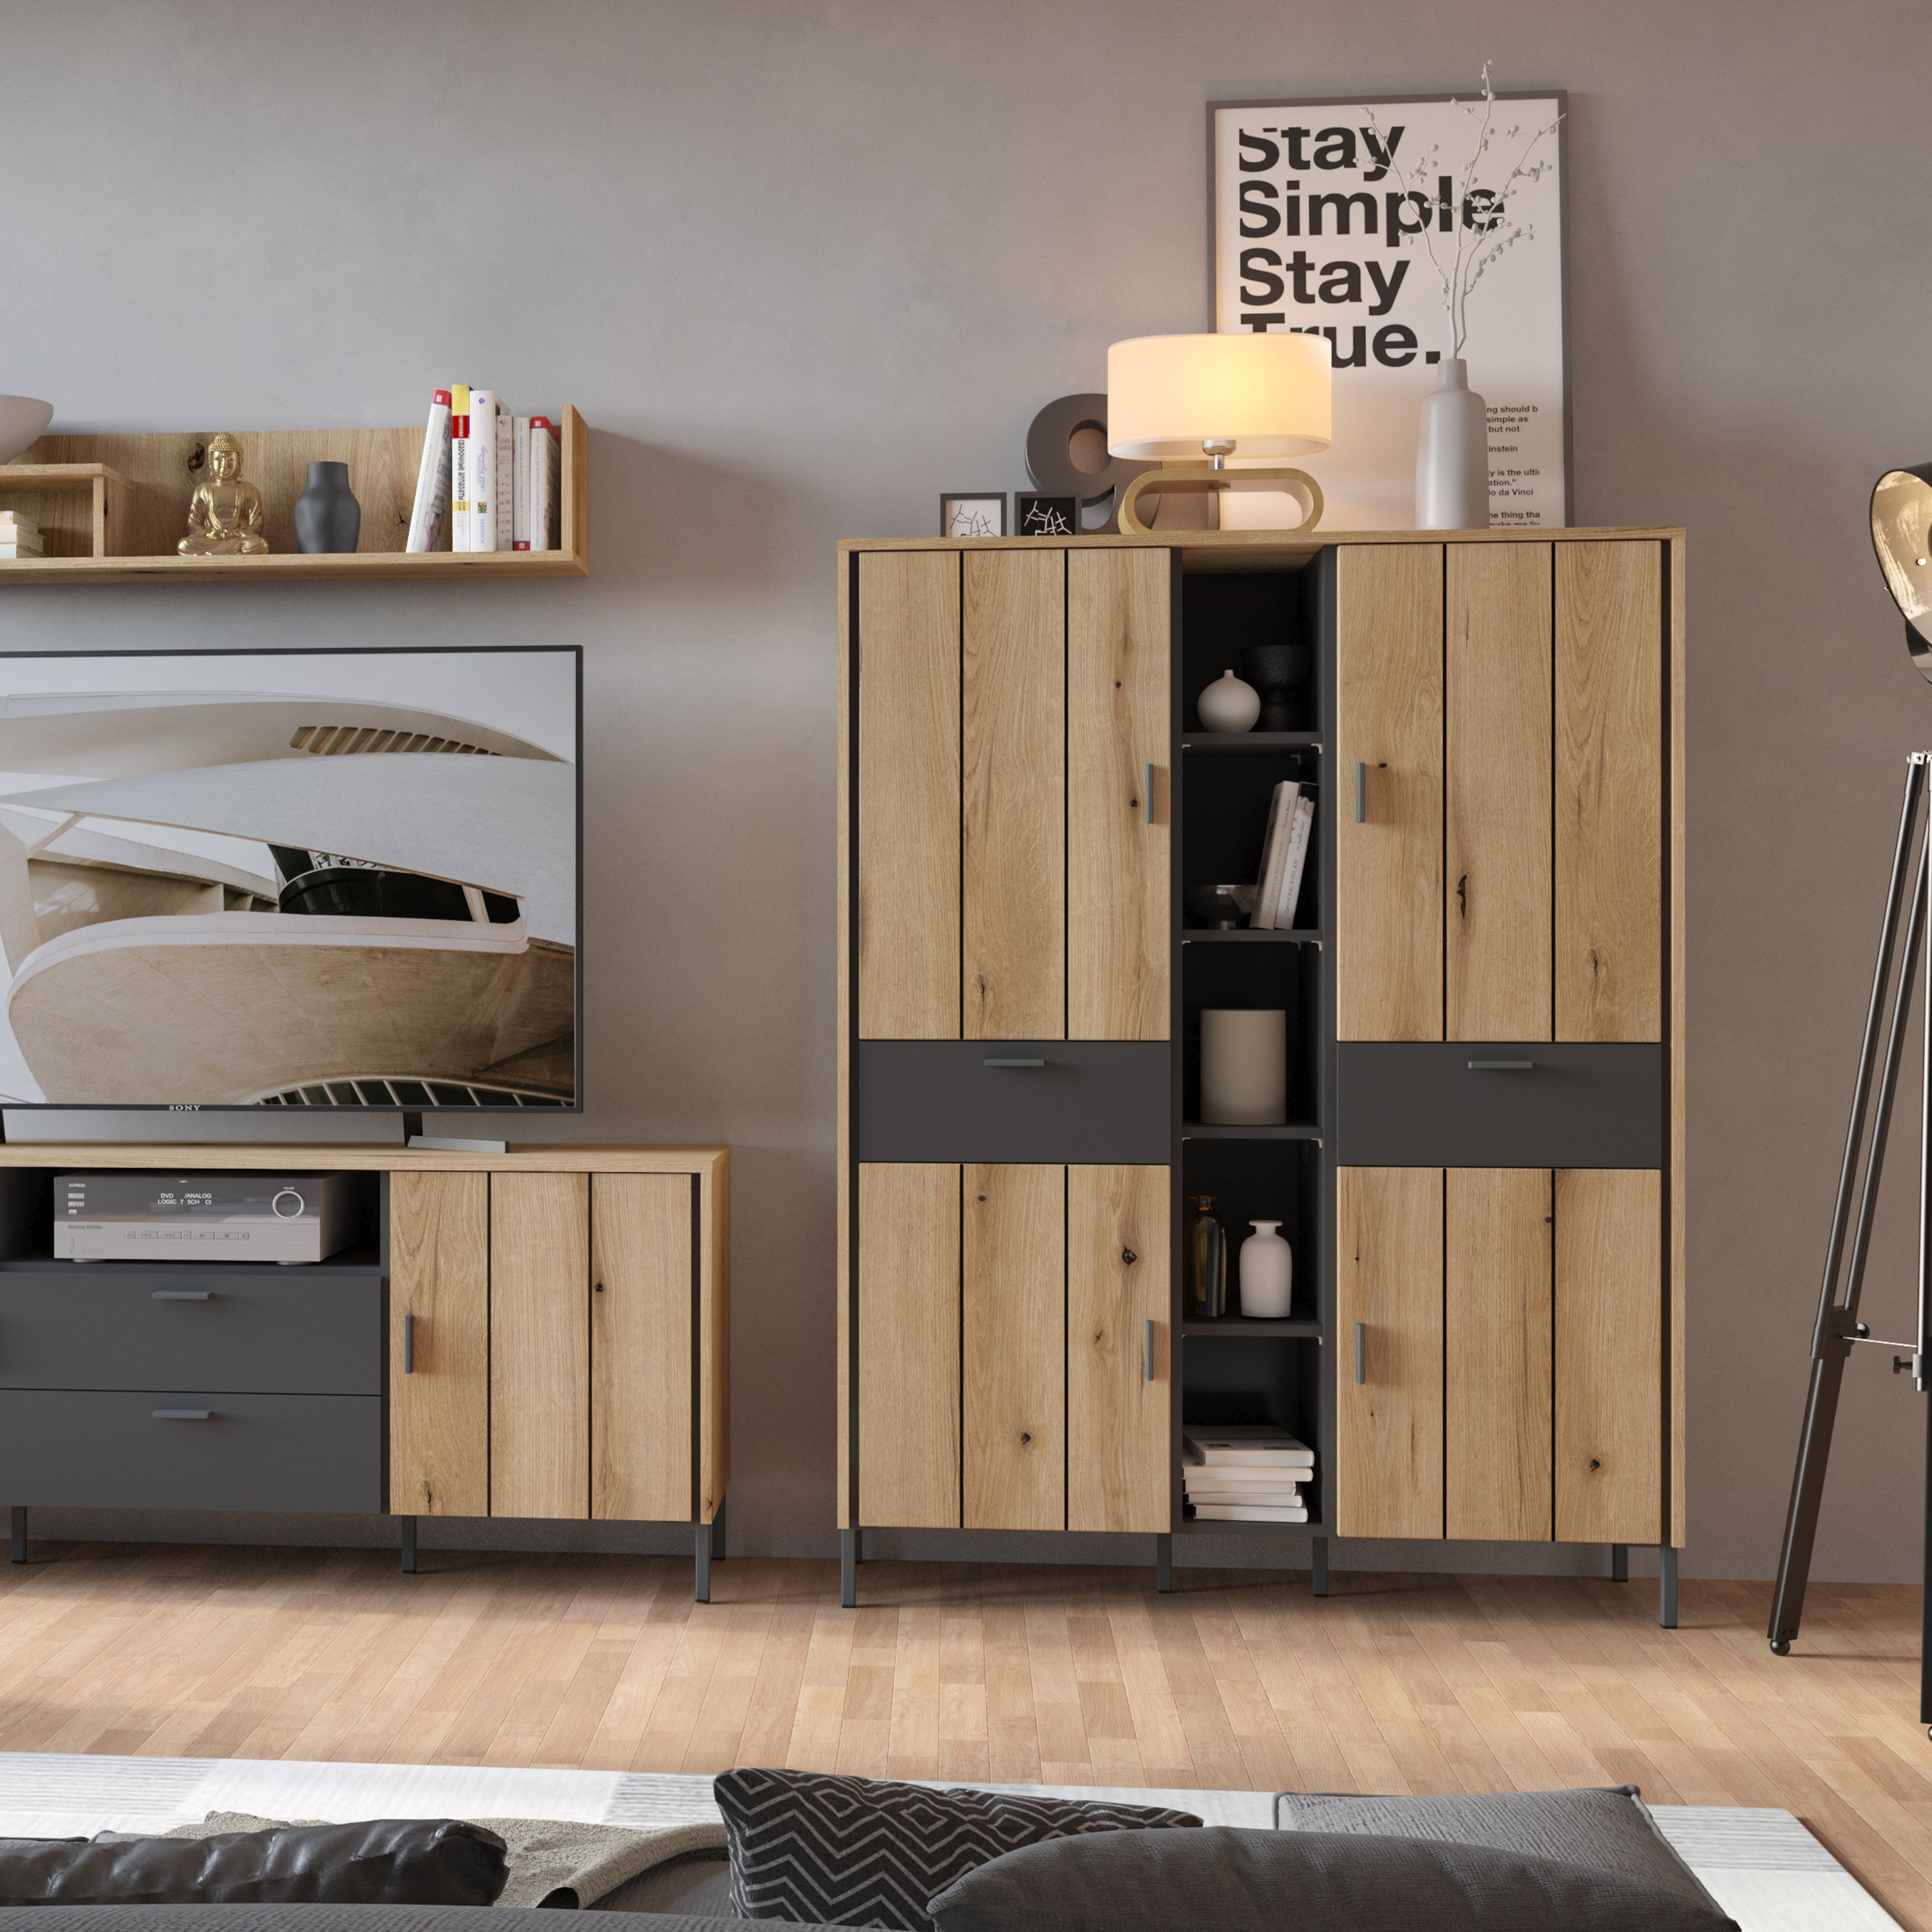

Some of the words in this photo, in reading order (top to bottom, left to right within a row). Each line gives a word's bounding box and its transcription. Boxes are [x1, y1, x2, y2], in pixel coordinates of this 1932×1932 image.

[1238, 126, 1406, 182] Stay
[1239, 175, 1505, 248] Simple
[1239, 247, 1411, 316] Stay
[1486, 415, 1515, 424] simple
